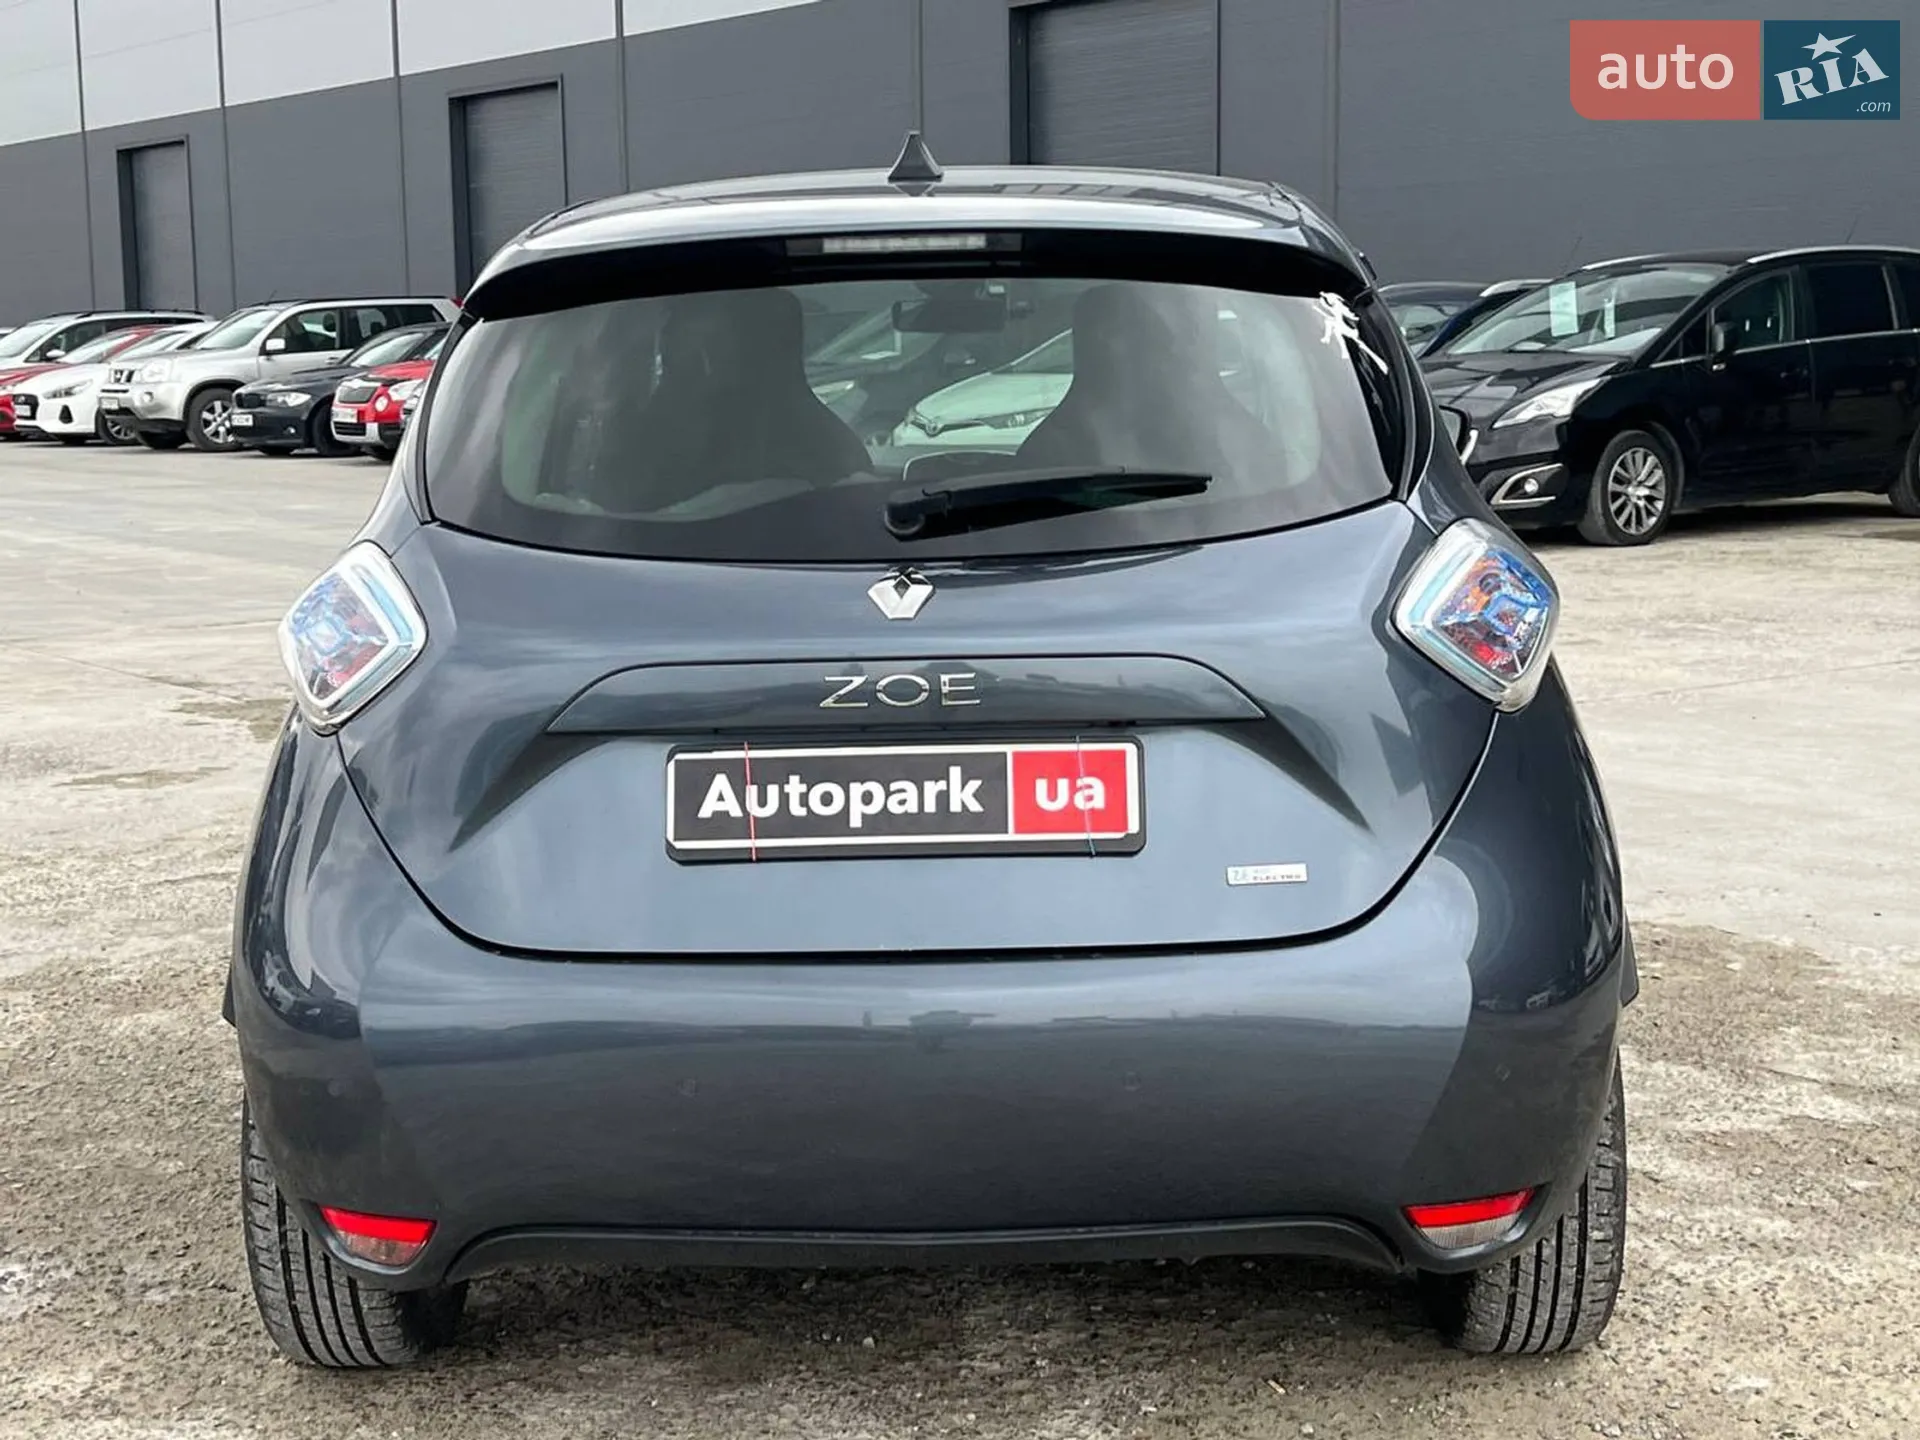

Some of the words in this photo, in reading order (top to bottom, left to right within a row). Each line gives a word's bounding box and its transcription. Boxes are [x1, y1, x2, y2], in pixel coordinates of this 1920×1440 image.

[819, 672, 982, 709] ZOE
[697, 766, 984, 828] Autopark
[1034, 776, 1106, 812] ua
